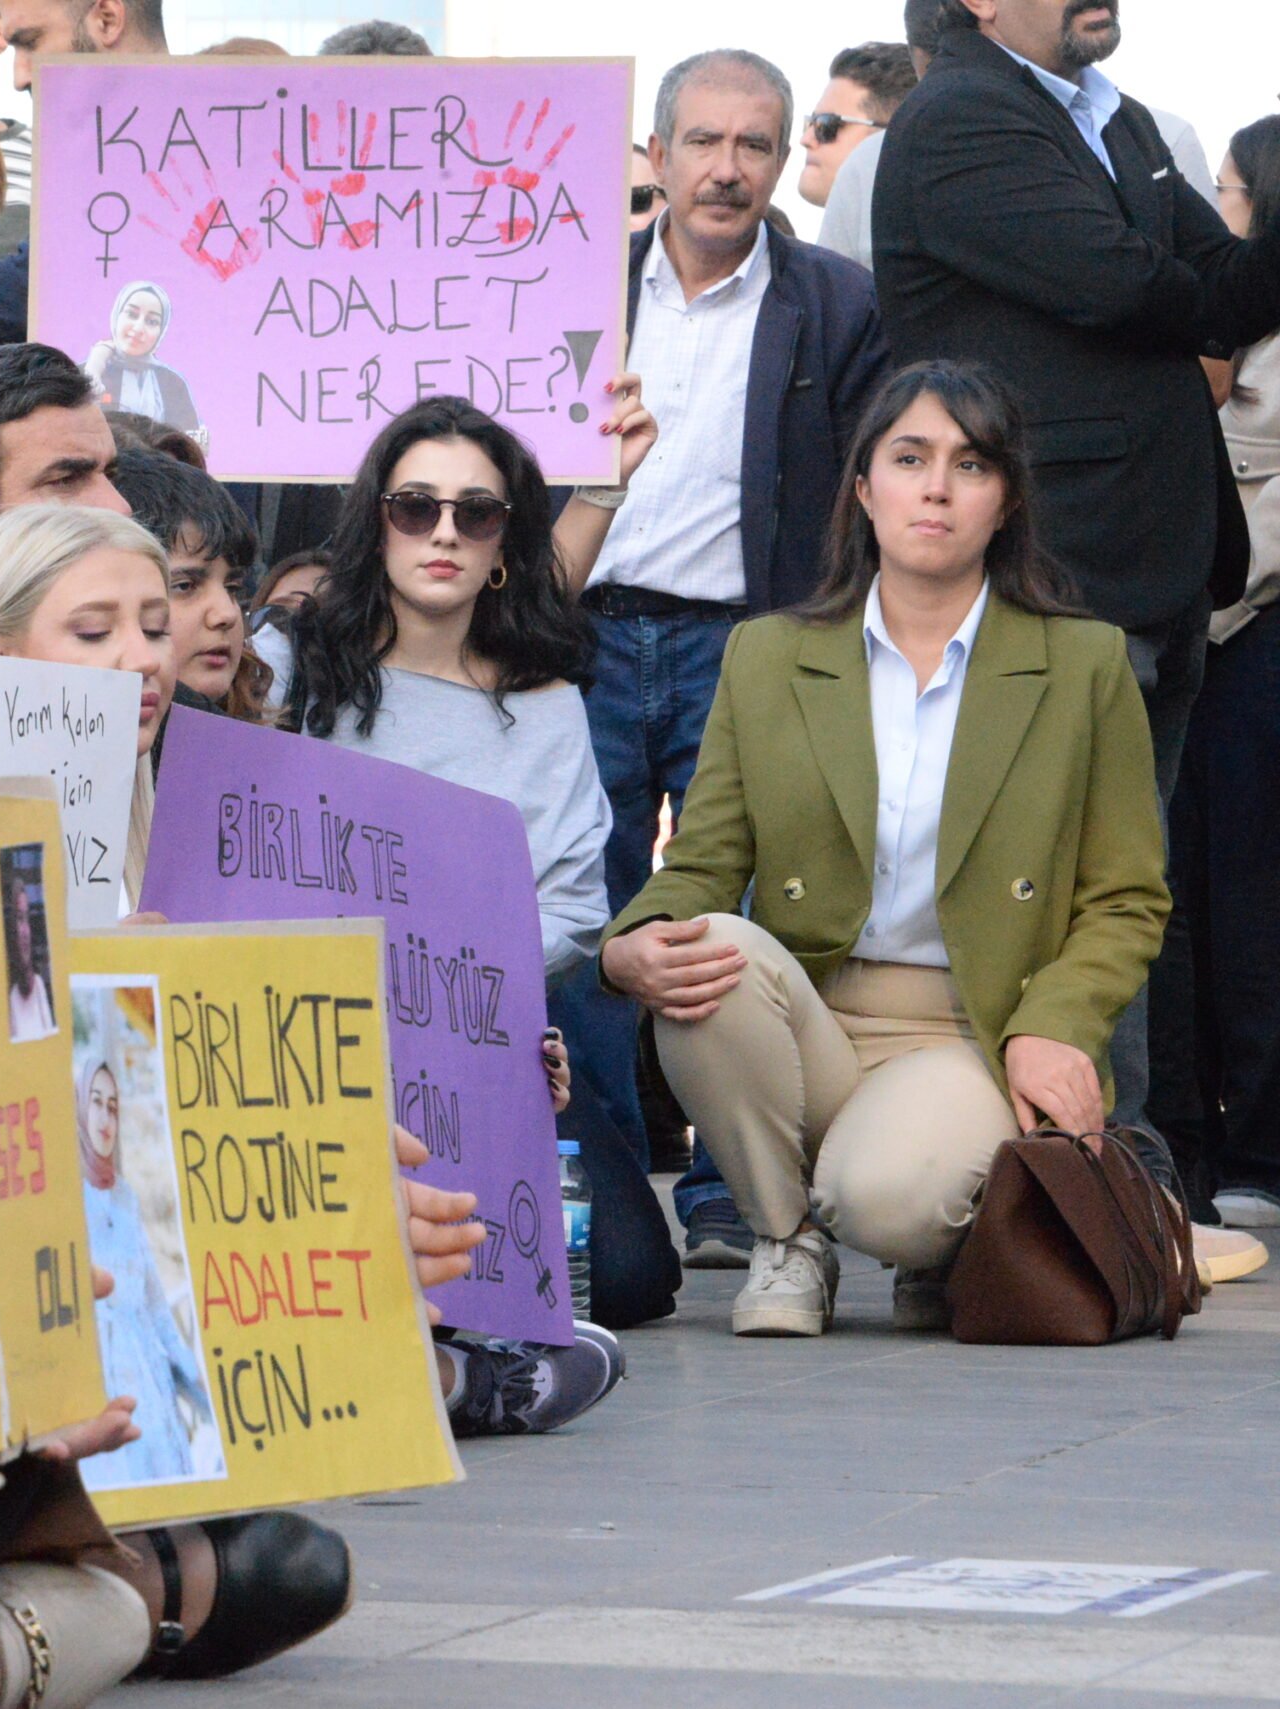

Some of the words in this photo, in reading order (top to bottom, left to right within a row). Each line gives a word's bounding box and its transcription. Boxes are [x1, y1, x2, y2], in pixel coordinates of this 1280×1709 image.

[95, 87, 513, 174] KATİLLER
[197, 183, 589, 257] ARAMIZDA
[255, 267, 548, 338] ADALET
[67, 830, 111, 887] YIZ
[219, 784, 408, 905] BİRLİKTE
[387, 932, 510, 1046] LÜYÜZ
[170, 985, 373, 1109] BİRLİKTE
[181, 1129, 348, 1224] ROJİNE
[203, 1249, 371, 1329] ADALET
